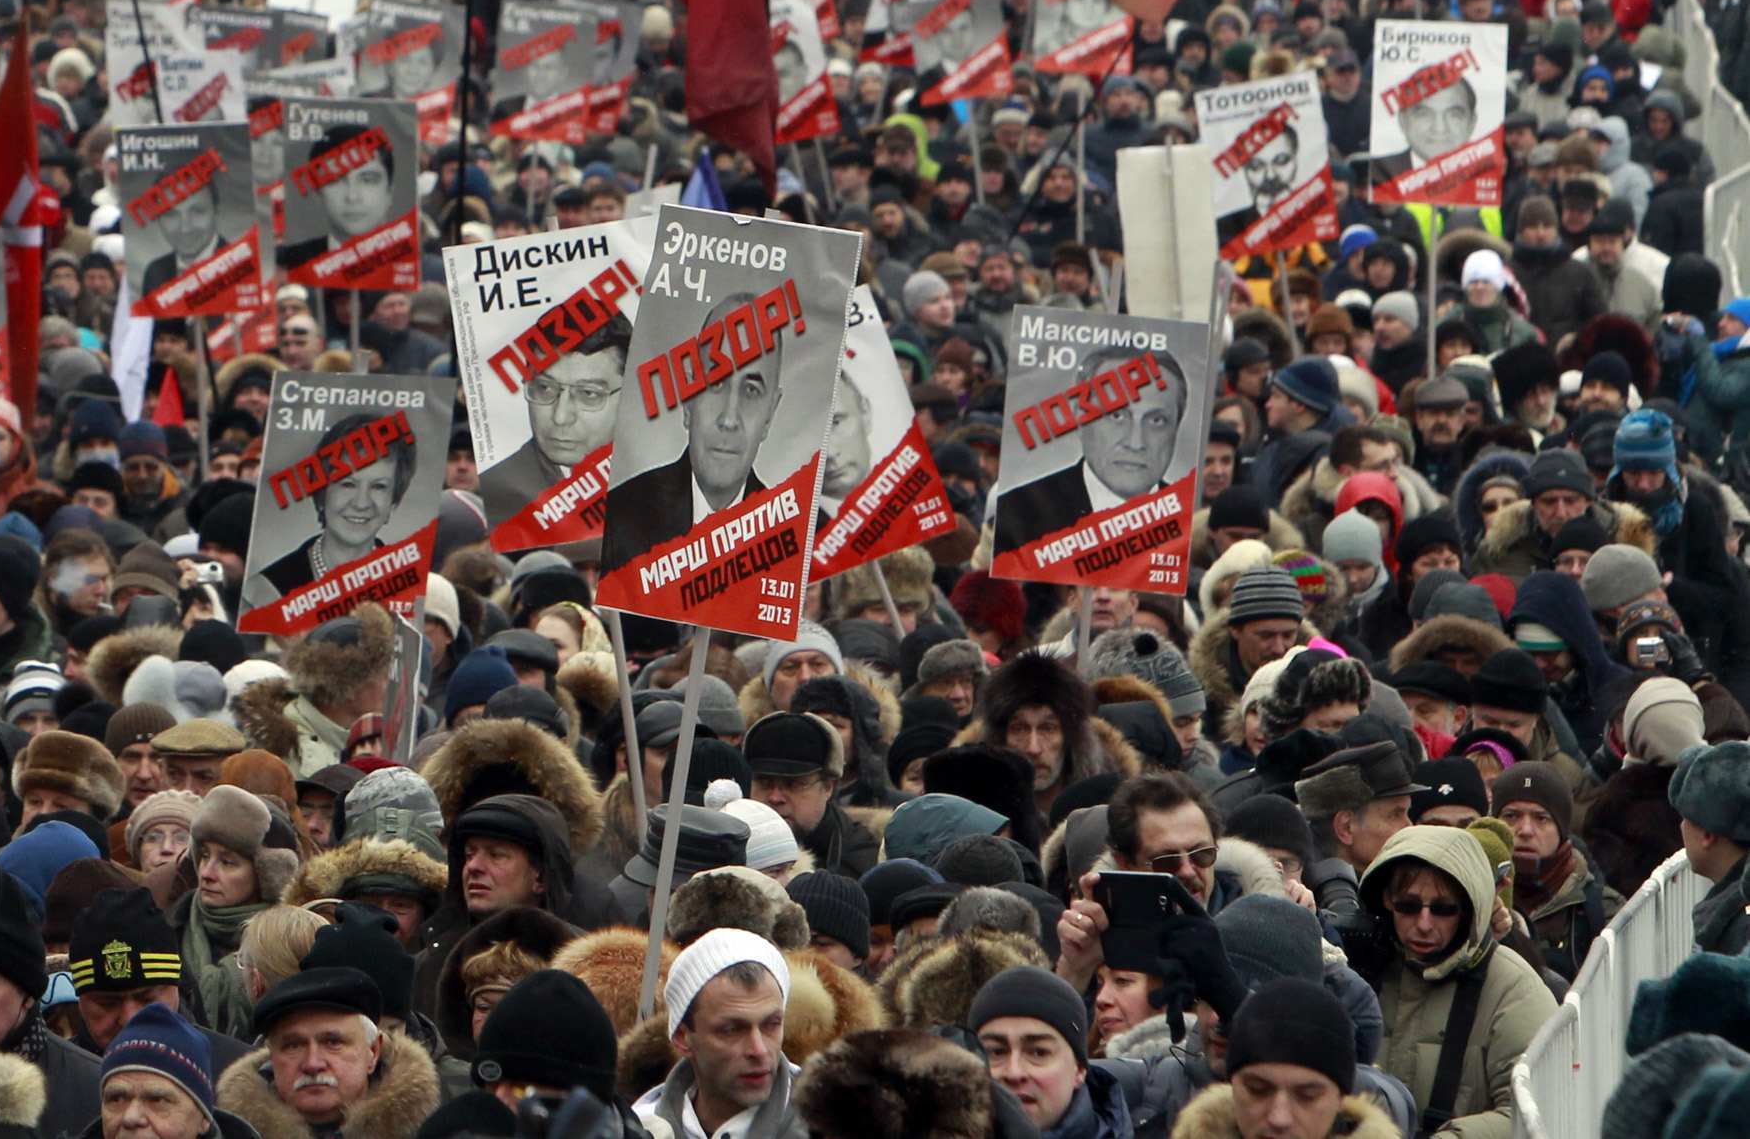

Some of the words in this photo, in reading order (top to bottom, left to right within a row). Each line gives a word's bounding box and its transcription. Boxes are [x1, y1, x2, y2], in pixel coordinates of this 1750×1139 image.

[1382, 27, 1472, 45] Бирюков
[288, 104, 369, 125] Гутенев
[121, 134, 199, 151] Игошин
[473, 235, 610, 282] Дискин
[663, 221, 788, 273] Эркенов
[477, 276, 552, 313] И.Е.
[650, 262, 712, 303] А.Ч.
[487, 258, 645, 395] ПОЗОР!
[1020, 316, 1168, 351] Максимов
[637, 278, 806, 420] ПОЗОР!
[1018, 344, 1084, 371] В.Ю.
[280, 380, 425, 408] Степанова
[1012, 352, 1168, 450] ПОЗОР!
[275, 407, 331, 432] З.М.
[268, 410, 417, 509] ПОЗОР!
[533, 468, 602, 531] МАРШ
[812, 509, 864, 565] МАРШ
[858, 444, 922, 517] ПРОТИВ
[851, 468, 933, 557] ПОДЛЕЦОВ
[912, 497, 942, 516] 13.01
[639, 535, 709, 595] МАРШ
[711, 488, 801, 557] ПРОТИВ
[918, 512, 948, 532] 2013
[1033, 526, 1099, 569] МАРШ
[1098, 492, 1183, 542] ПРОТИВ
[680, 527, 801, 612] ПОДЛЕЦОВ
[1073, 520, 1183, 578] ПОДЛЕЦОВ
[1150, 552, 1181, 567] 13.01
[282, 580, 340, 622] МАРШ
[342, 542, 421, 592] ПРОТИВ
[760, 576, 795, 599] 13.01
[1149, 569, 1180, 584] 2013
[757, 603, 792, 625] 2013
